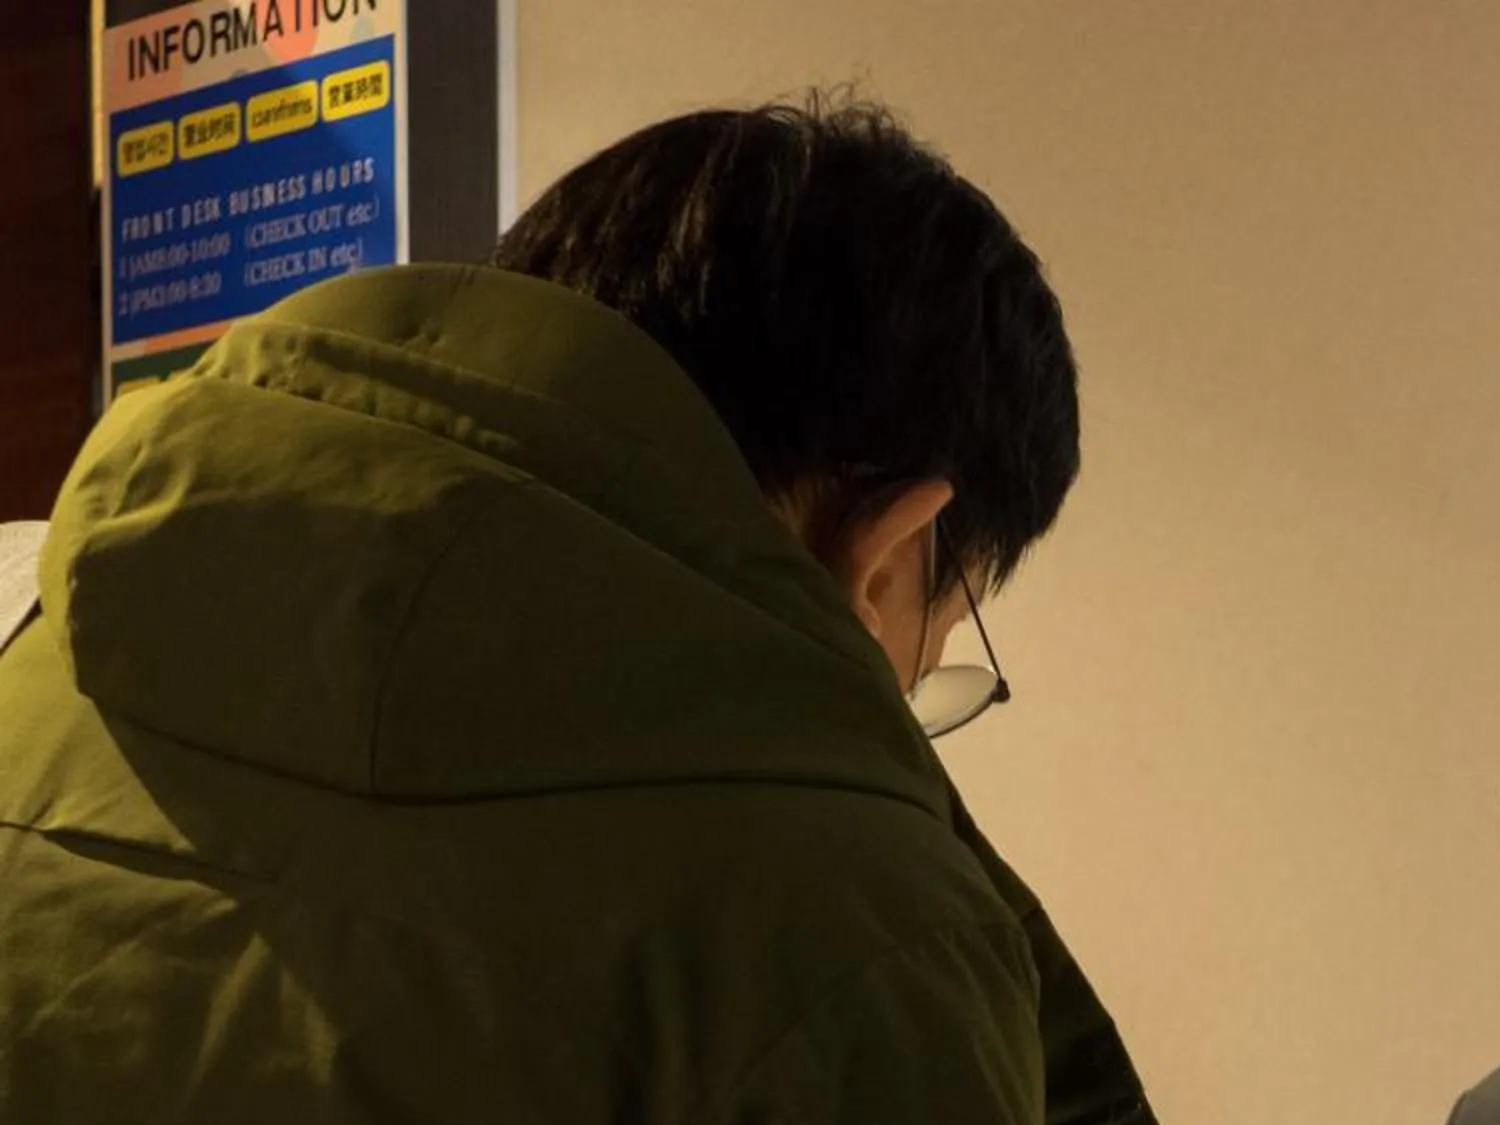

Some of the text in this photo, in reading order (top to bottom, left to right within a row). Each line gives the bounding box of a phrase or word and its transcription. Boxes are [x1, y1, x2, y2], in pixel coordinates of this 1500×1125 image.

[121, 156, 375, 243] FRONT DESK BUSINESS HOURS
